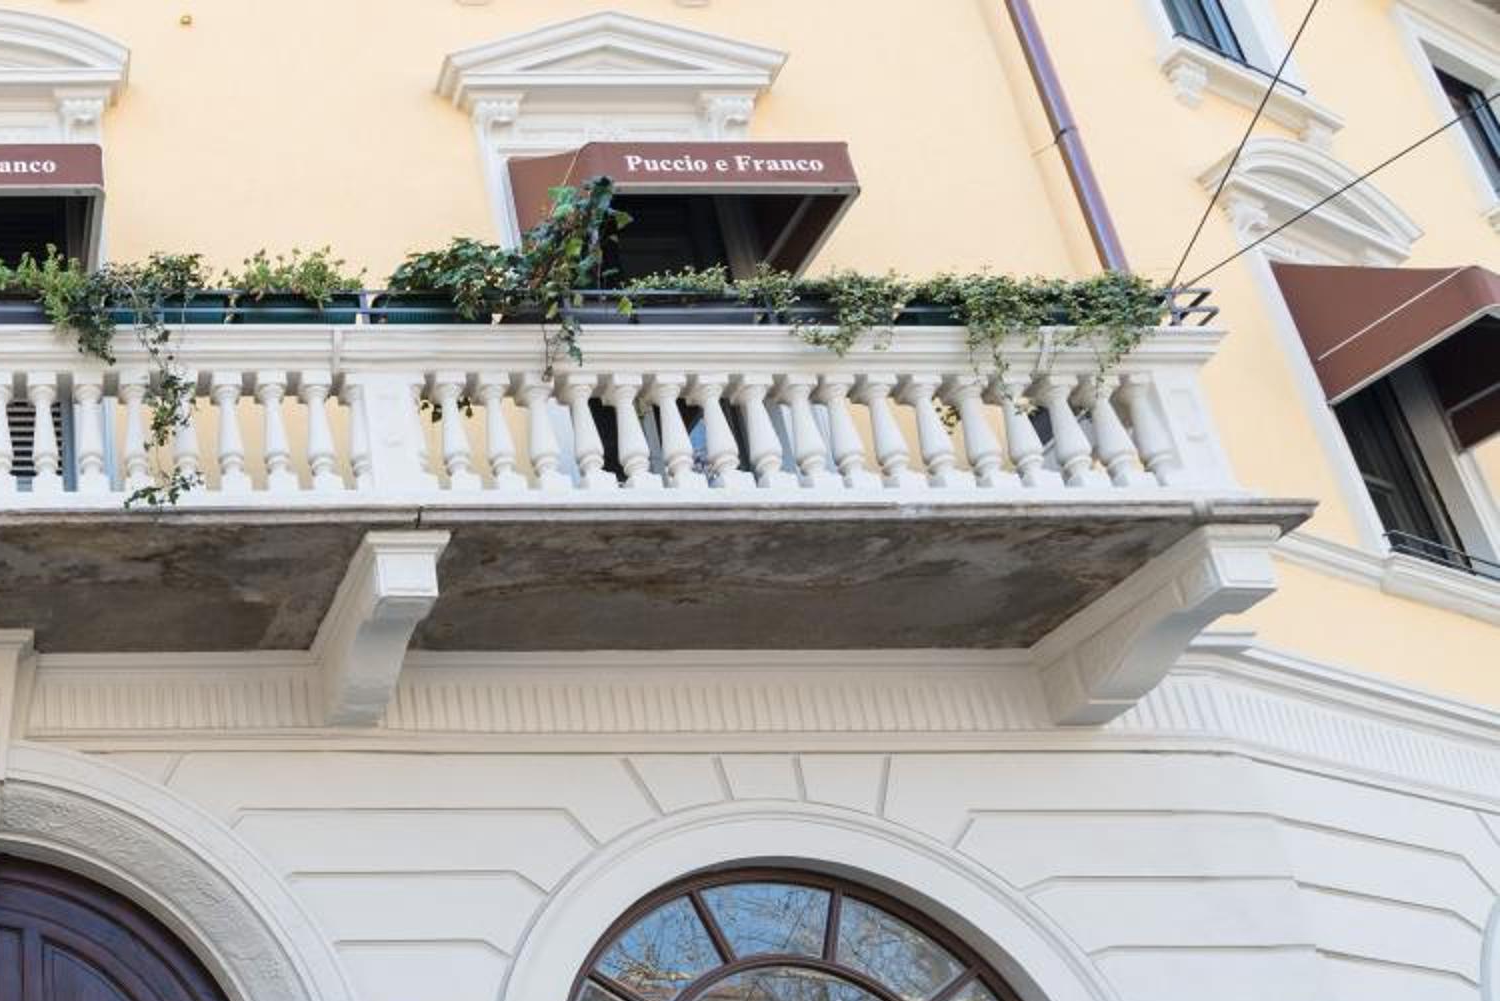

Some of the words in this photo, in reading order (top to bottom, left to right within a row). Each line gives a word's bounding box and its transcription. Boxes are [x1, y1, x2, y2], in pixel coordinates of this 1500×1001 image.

[625, 154, 708, 172] Puccio
[716, 158, 729, 172] e
[734, 154, 824, 172] Franco
